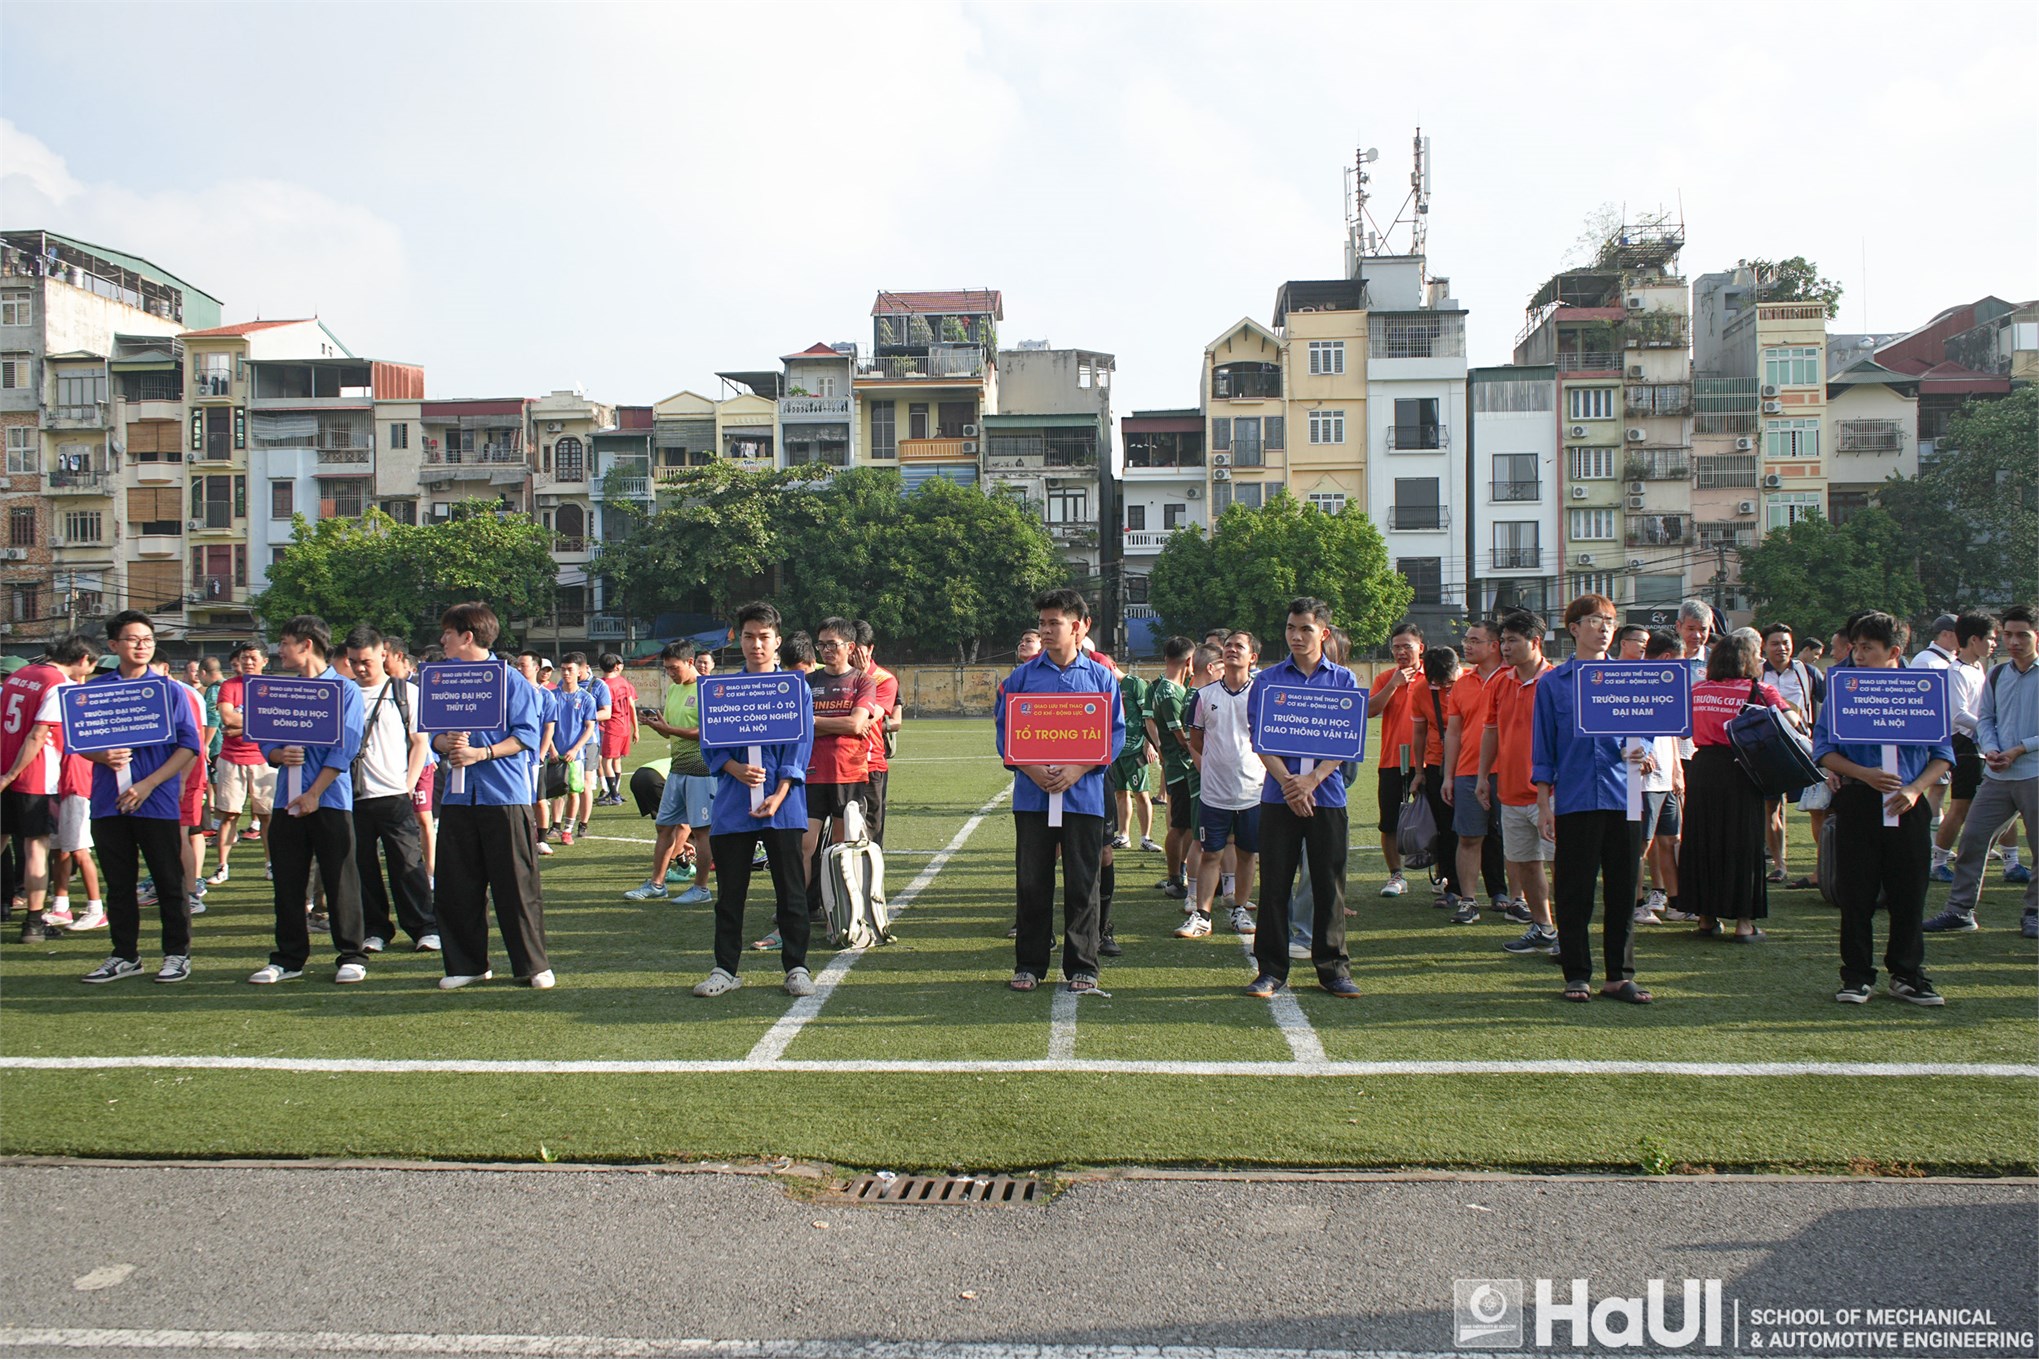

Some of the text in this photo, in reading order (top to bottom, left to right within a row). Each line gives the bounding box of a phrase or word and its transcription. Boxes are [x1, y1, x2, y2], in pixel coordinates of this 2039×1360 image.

[431, 691, 492, 701] TRƯỜNG ĐẠI HỌC
[1592, 694, 1674, 705] TRƯỜNG ĐẠI HỌC
[1724, 697, 1735, 705] CƠ
[1736, 698, 1748, 706] KH
[1853, 695, 1889, 704] TRƯỜNG
[1908, 696, 1923, 704] KHÍ
[84, 706, 146, 718] TRƯỜNG ĐẠI HỌC
[446, 702, 477, 712] THỦY LỢI
[709, 703, 741, 712] TRƯỜNG
[758, 702, 770, 710] KHÍ
[777, 701, 783, 709] Ô
[1843, 708, 1857, 716] ĐẠI
[1860, 708, 1880, 716] HỌC
[1883, 707, 1907, 715] BÁCH
[4, 693, 25, 734] 5
[257, 707, 328, 719] TRƯỜNG ĐẠI HỌC
[708, 711, 798, 725] ĐẠI HỌC CÔNG NGHIỆP
[1613, 709, 1629, 717] ĐẠI
[87, 718, 108, 726] THUẬT
[110, 715, 132, 724] CÔNG
[134, 713, 160, 721] NGHIỆP
[273, 718, 313, 728] ĐÔNG ĐÔ
[1273, 714, 1350, 728] TRƯỜNG ĐẠI HỌC
[1874, 718, 1905, 728] HÀ NỘI
[79, 729, 92, 737] ĐẠI
[130, 722, 158, 730] NGUYÊN
[740, 724, 767, 733] HÀ NỘI
[1016, 724, 1100, 742] TỔ TRỌNG TÀI
[1264, 726, 1357, 740] GIAO THÔNG VẬN TẢI
[1132, 774, 1139, 786] 8
[701, 807, 708, 820] 8
